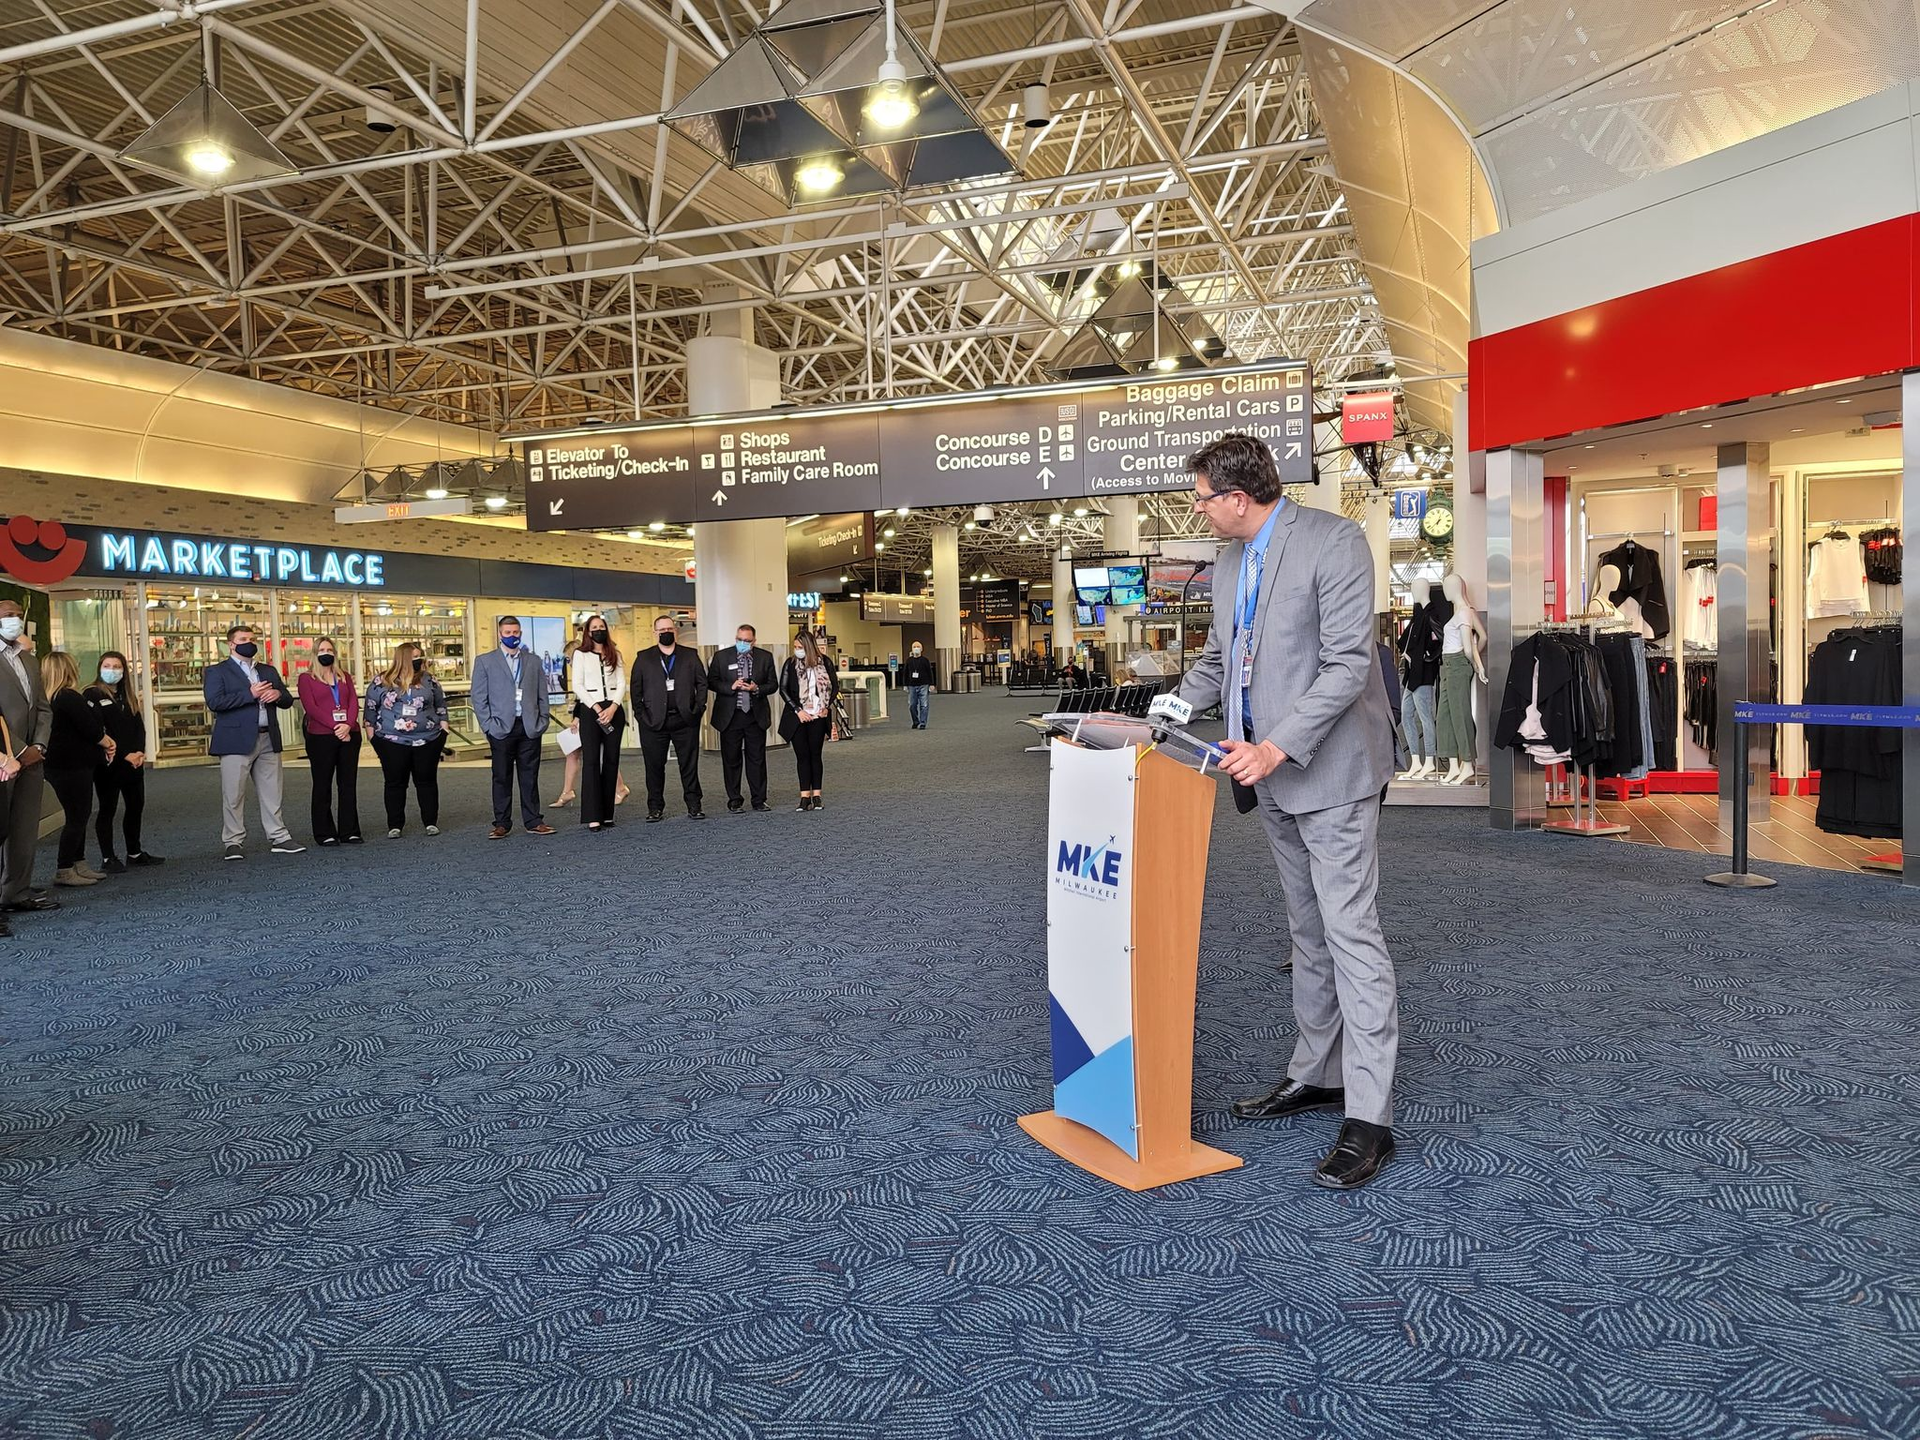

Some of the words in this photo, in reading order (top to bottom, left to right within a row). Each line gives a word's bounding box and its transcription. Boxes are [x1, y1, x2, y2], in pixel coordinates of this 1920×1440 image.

[1126, 381, 1214, 405] Baggage
[1221, 375, 1280, 395] Claim
[1098, 400, 1231, 428] Parking/Rental
[1237, 399, 1281, 417] Cars
[1348, 412, 1388, 423] SPANX
[740, 432, 790, 449] Shops
[935, 431, 1031, 451] Concourse
[1038, 427, 1052, 443] D
[1087, 434, 1149, 453] Ground
[547, 447, 605, 463] Elevator
[611, 444, 629, 459] To
[740, 446, 826, 466] Restaurant
[936, 451, 1031, 471] Concourse
[1039, 446, 1051, 463] E
[1120, 453, 1186, 472] Center
[548, 456, 689, 480] Ticketing/Check-In
[741, 466, 789, 484] Family
[793, 465, 830, 481] Care
[832, 462, 878, 478] Room
[1091, 474, 1142, 490] (Access
[1146, 474, 1160, 486] to
[1163, 472, 1198, 484] Movi
[388, 503, 409, 517] EXIT
[818, 534, 837, 548] Ticketing
[100, 533, 385, 586] MARKETPLACE
[1169, 701, 1189, 717] MKE
[1734, 709, 1754, 718] MKE
[1790, 709, 1811, 719] MKE
[1850, 711, 1873, 721] MKE
[1057, 840, 1122, 887] MKE
[1055, 877, 1117, 900] MILWAUKEE
